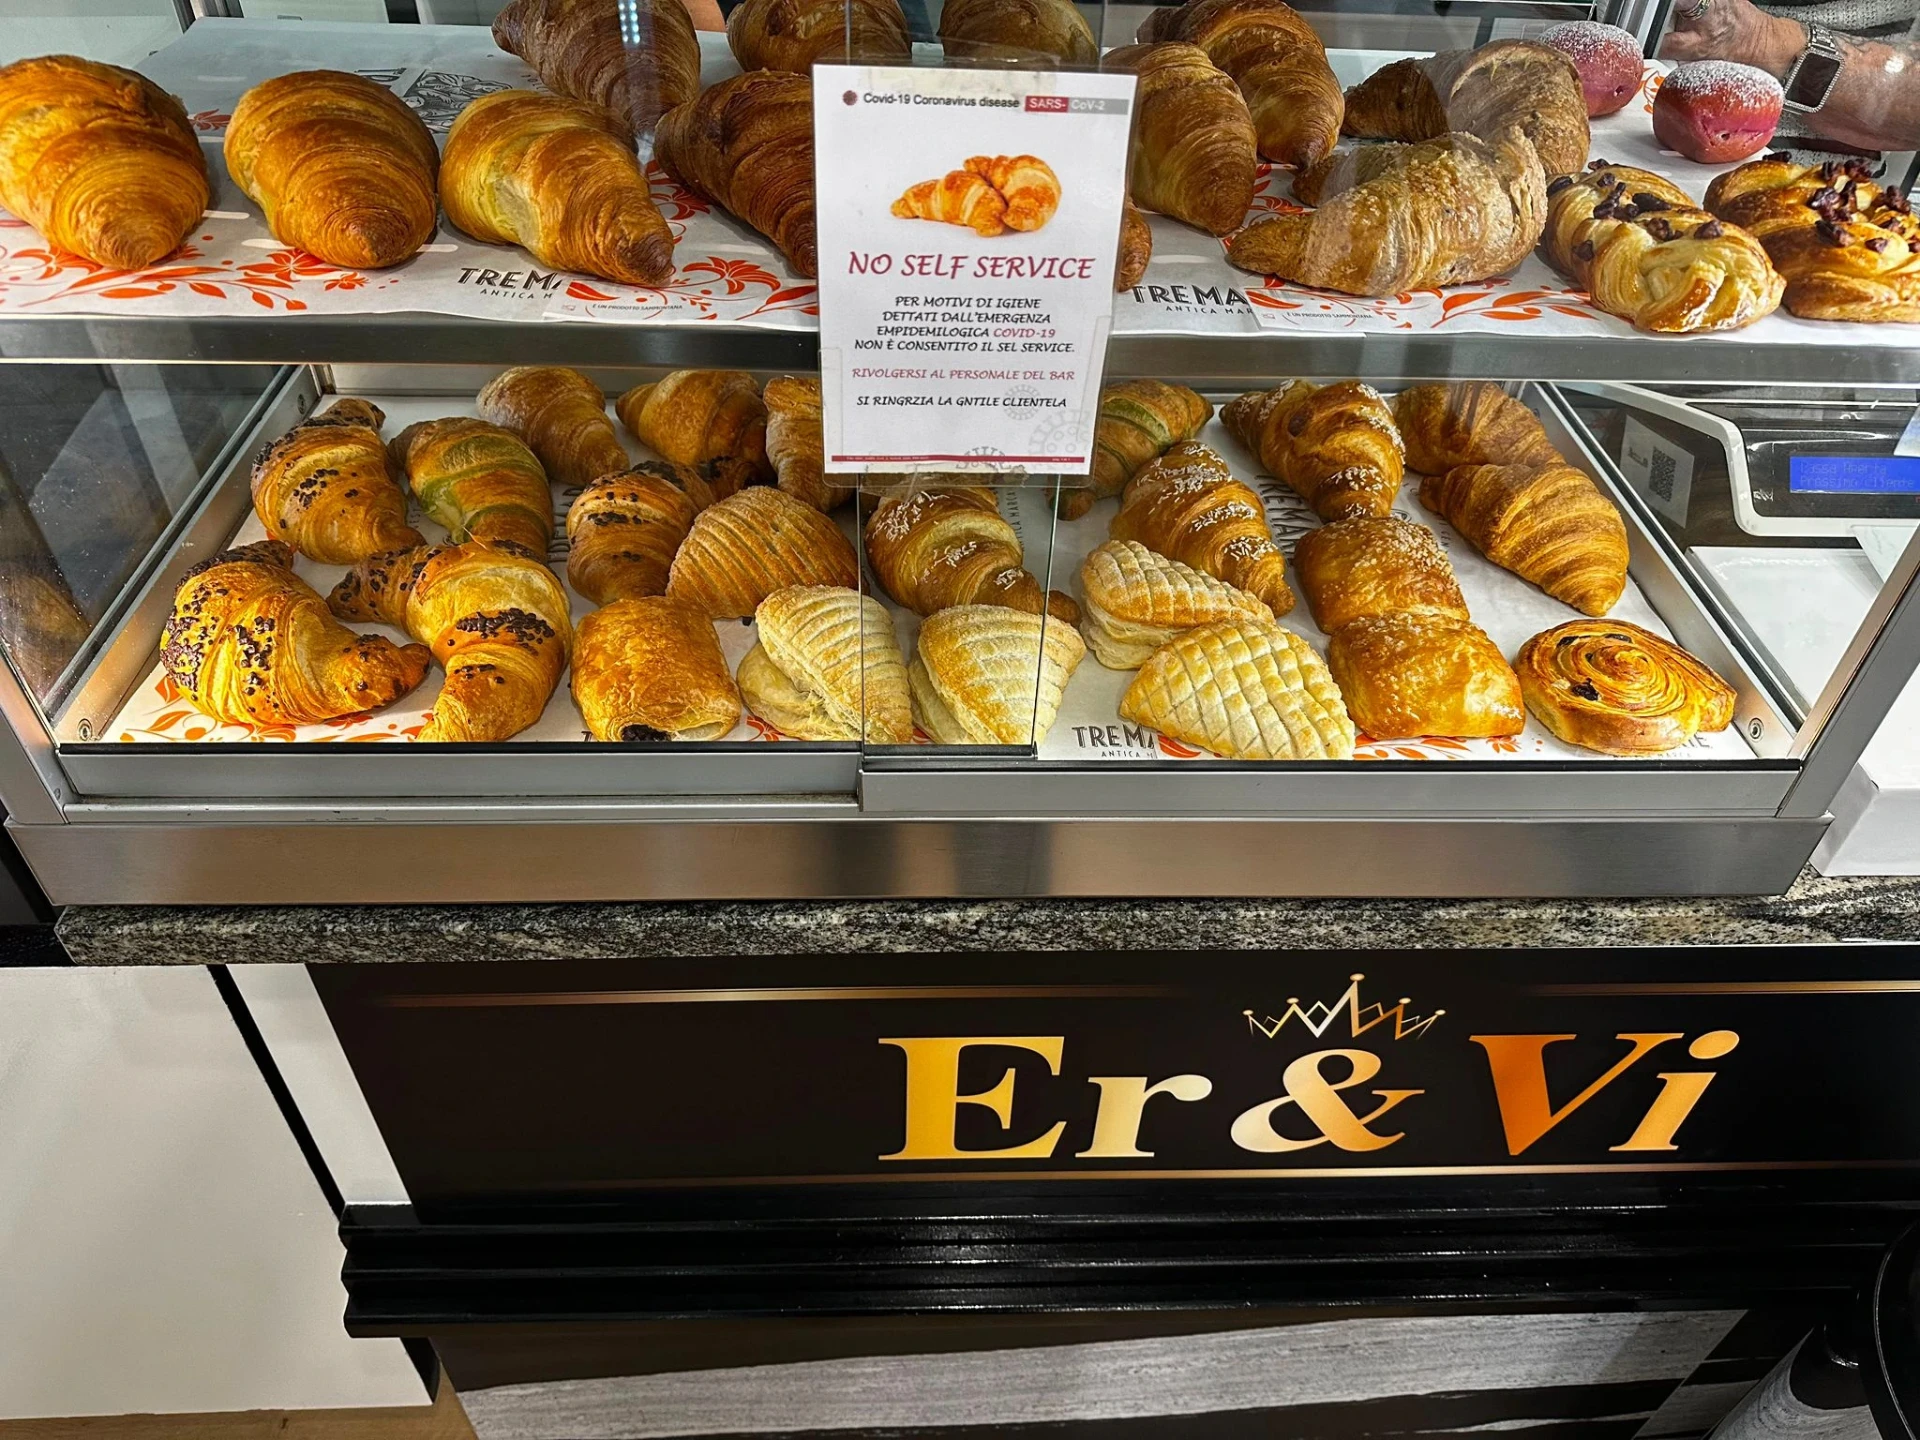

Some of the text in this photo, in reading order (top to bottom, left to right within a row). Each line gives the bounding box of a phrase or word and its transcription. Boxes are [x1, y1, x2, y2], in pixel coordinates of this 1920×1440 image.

[862, 92, 911, 104] Covid-19
[913, 94, 976, 107] Coronavirus
[979, 95, 1020, 108] disease
[849, 251, 1096, 280] NO SELF SERVICE
[480, 288, 535, 299] ANTICA
[895, 296, 1042, 309] PER MOTIVI DI IGIENE
[1165, 305, 1217, 314] ANTICA
[882, 311, 1051, 324] DETTATI DALL'EMERGENZA
[877, 326, 1056, 339] EMPIDEMILOGICA COVID-19
[854, 338, 1075, 353] NON È CONSENTITO IL SEL SERVICE.
[852, 368, 1075, 381] RIVOLGERSI AL PERSONALE DEL BAR
[857, 395, 1067, 408] SI RINGRZIA LA GNTILE CLIENTELA
[1101, 750, 1141, 758] ANTICA
[878, 1029, 1740, 1160] Er & Vi
